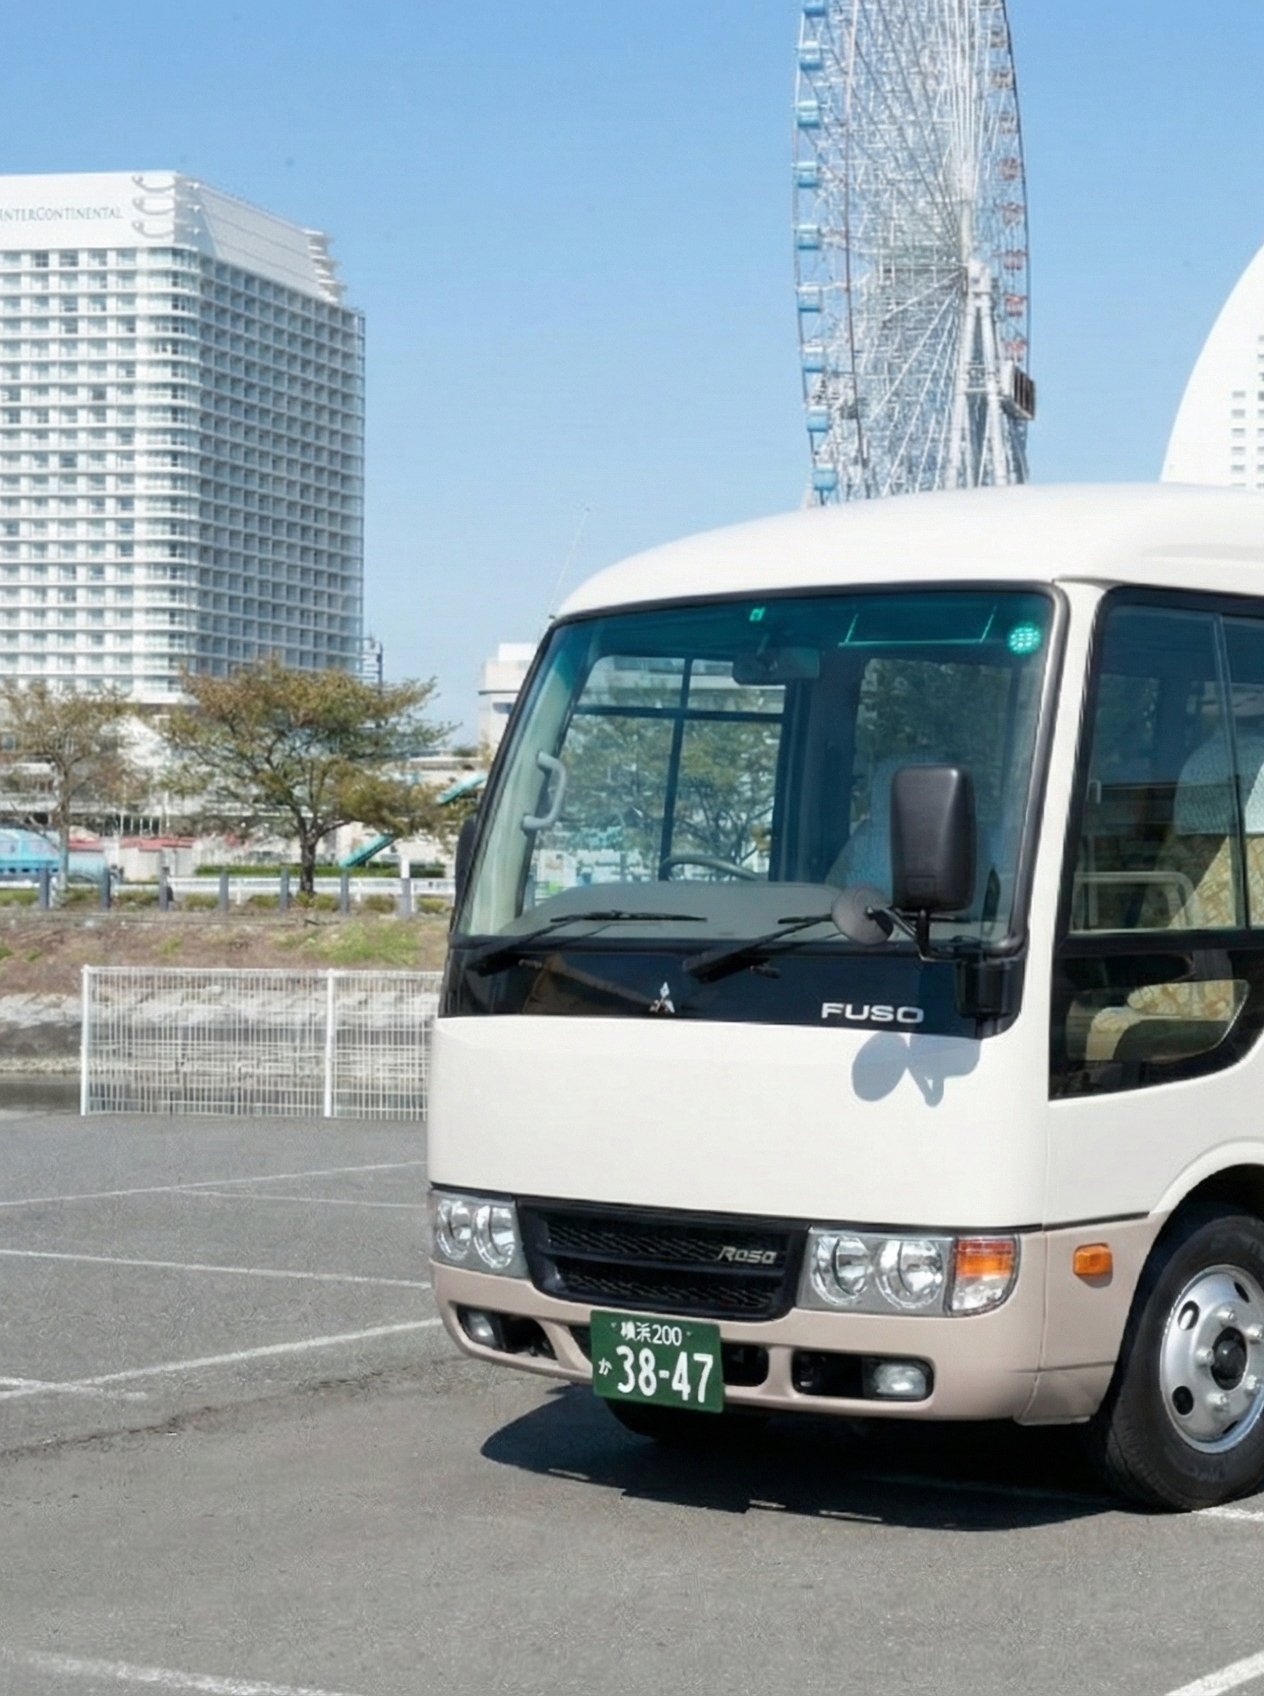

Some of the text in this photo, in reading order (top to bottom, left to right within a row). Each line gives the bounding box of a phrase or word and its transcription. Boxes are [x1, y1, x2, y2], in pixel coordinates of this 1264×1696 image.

[821, 1002, 924, 1023] FUSO
[717, 1245, 777, 1264] Rosa
[616, 1345, 714, 1403] 38-47
